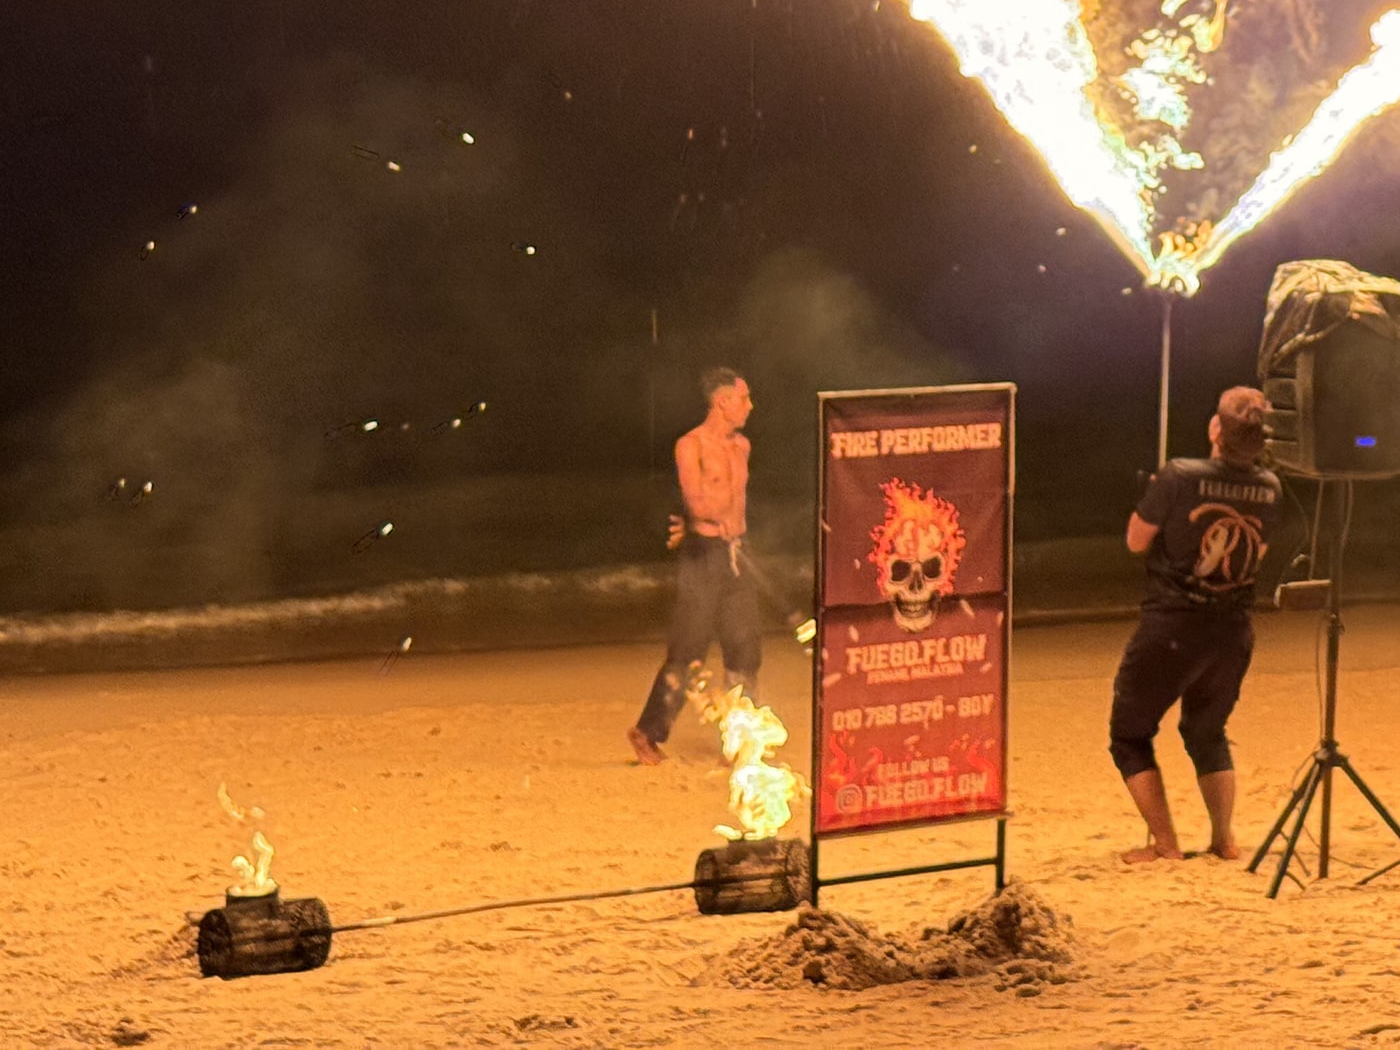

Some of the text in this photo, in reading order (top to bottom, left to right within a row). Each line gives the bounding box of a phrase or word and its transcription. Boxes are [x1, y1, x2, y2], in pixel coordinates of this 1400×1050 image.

[831, 422, 1001, 458] FIRE PERFORMER
[846, 634, 987, 674] FUEGO.FLOW
[832, 709, 862, 731] 010
